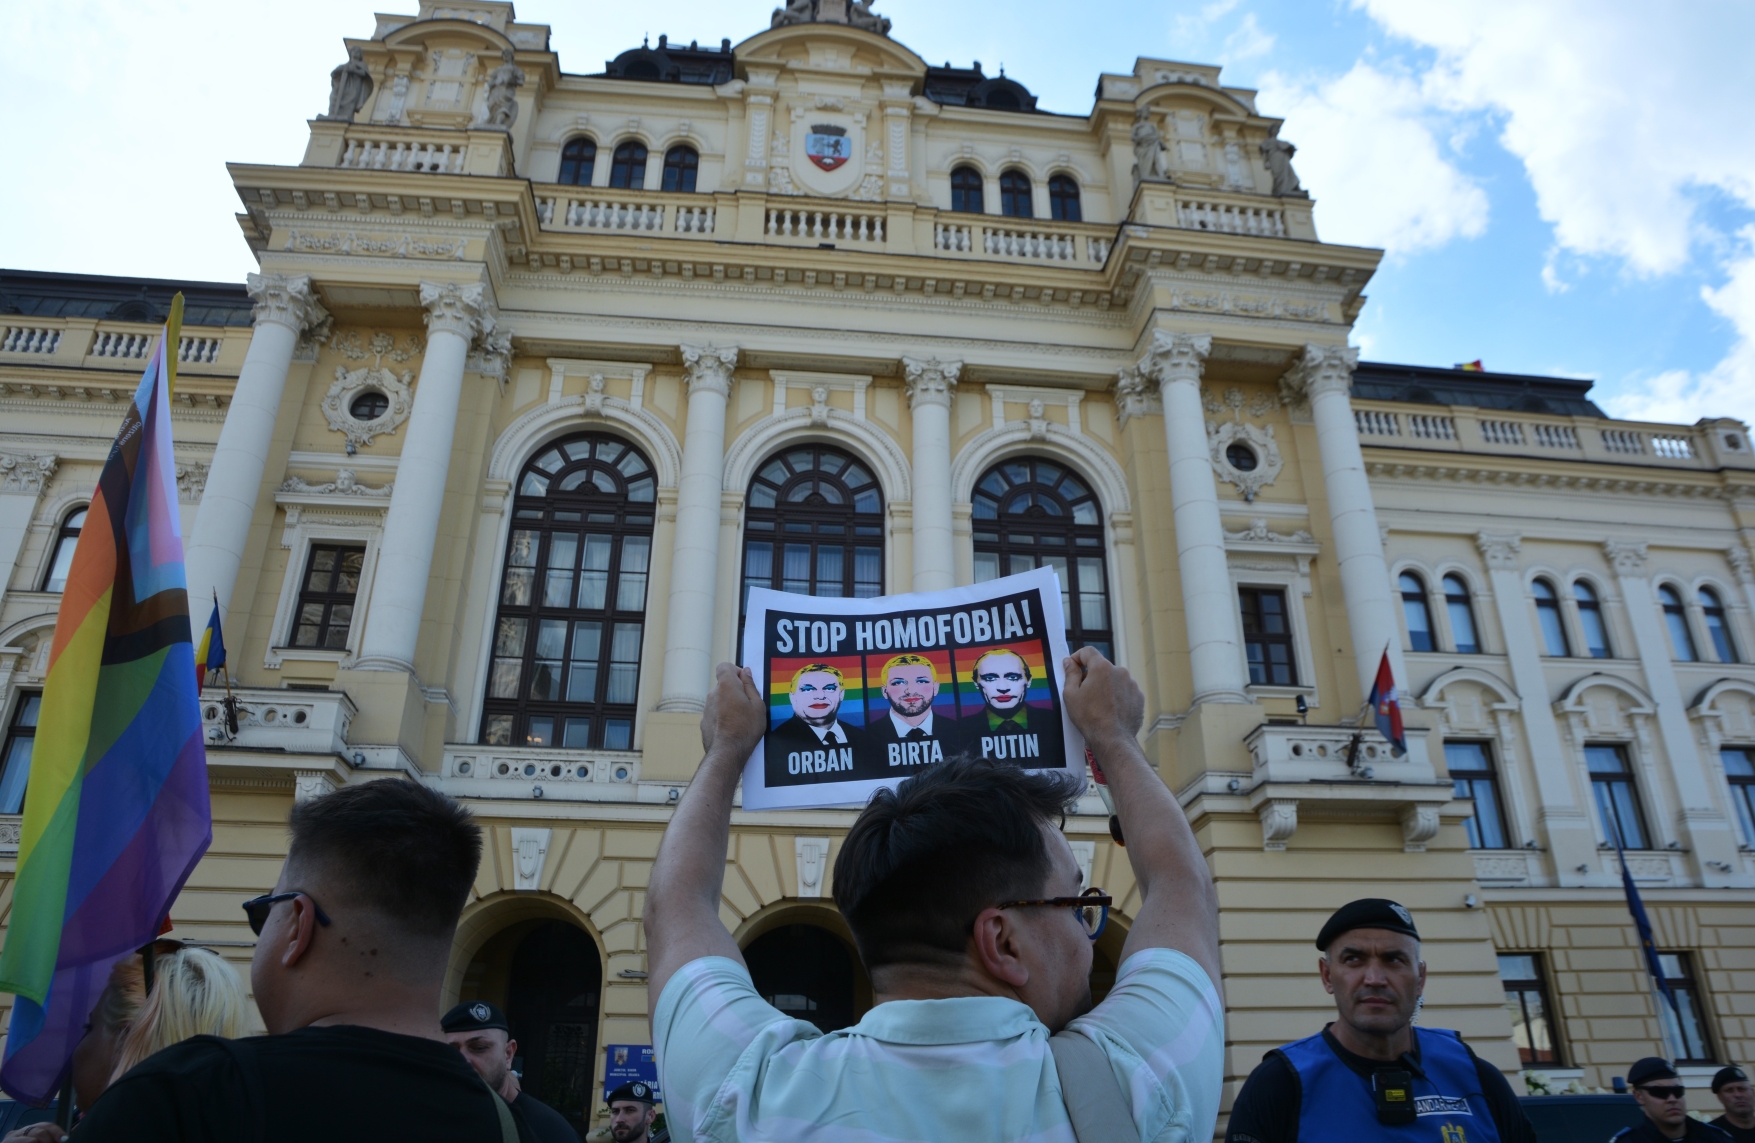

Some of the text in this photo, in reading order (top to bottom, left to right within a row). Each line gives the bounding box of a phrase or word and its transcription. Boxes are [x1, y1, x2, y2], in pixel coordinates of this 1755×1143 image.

[776, 599, 1034, 654] STOP HOMOFOBIA!
[788, 747, 853, 775] ORBAN
[888, 739, 944, 767] BIRTA
[981, 734, 1040, 760] PUTIN
